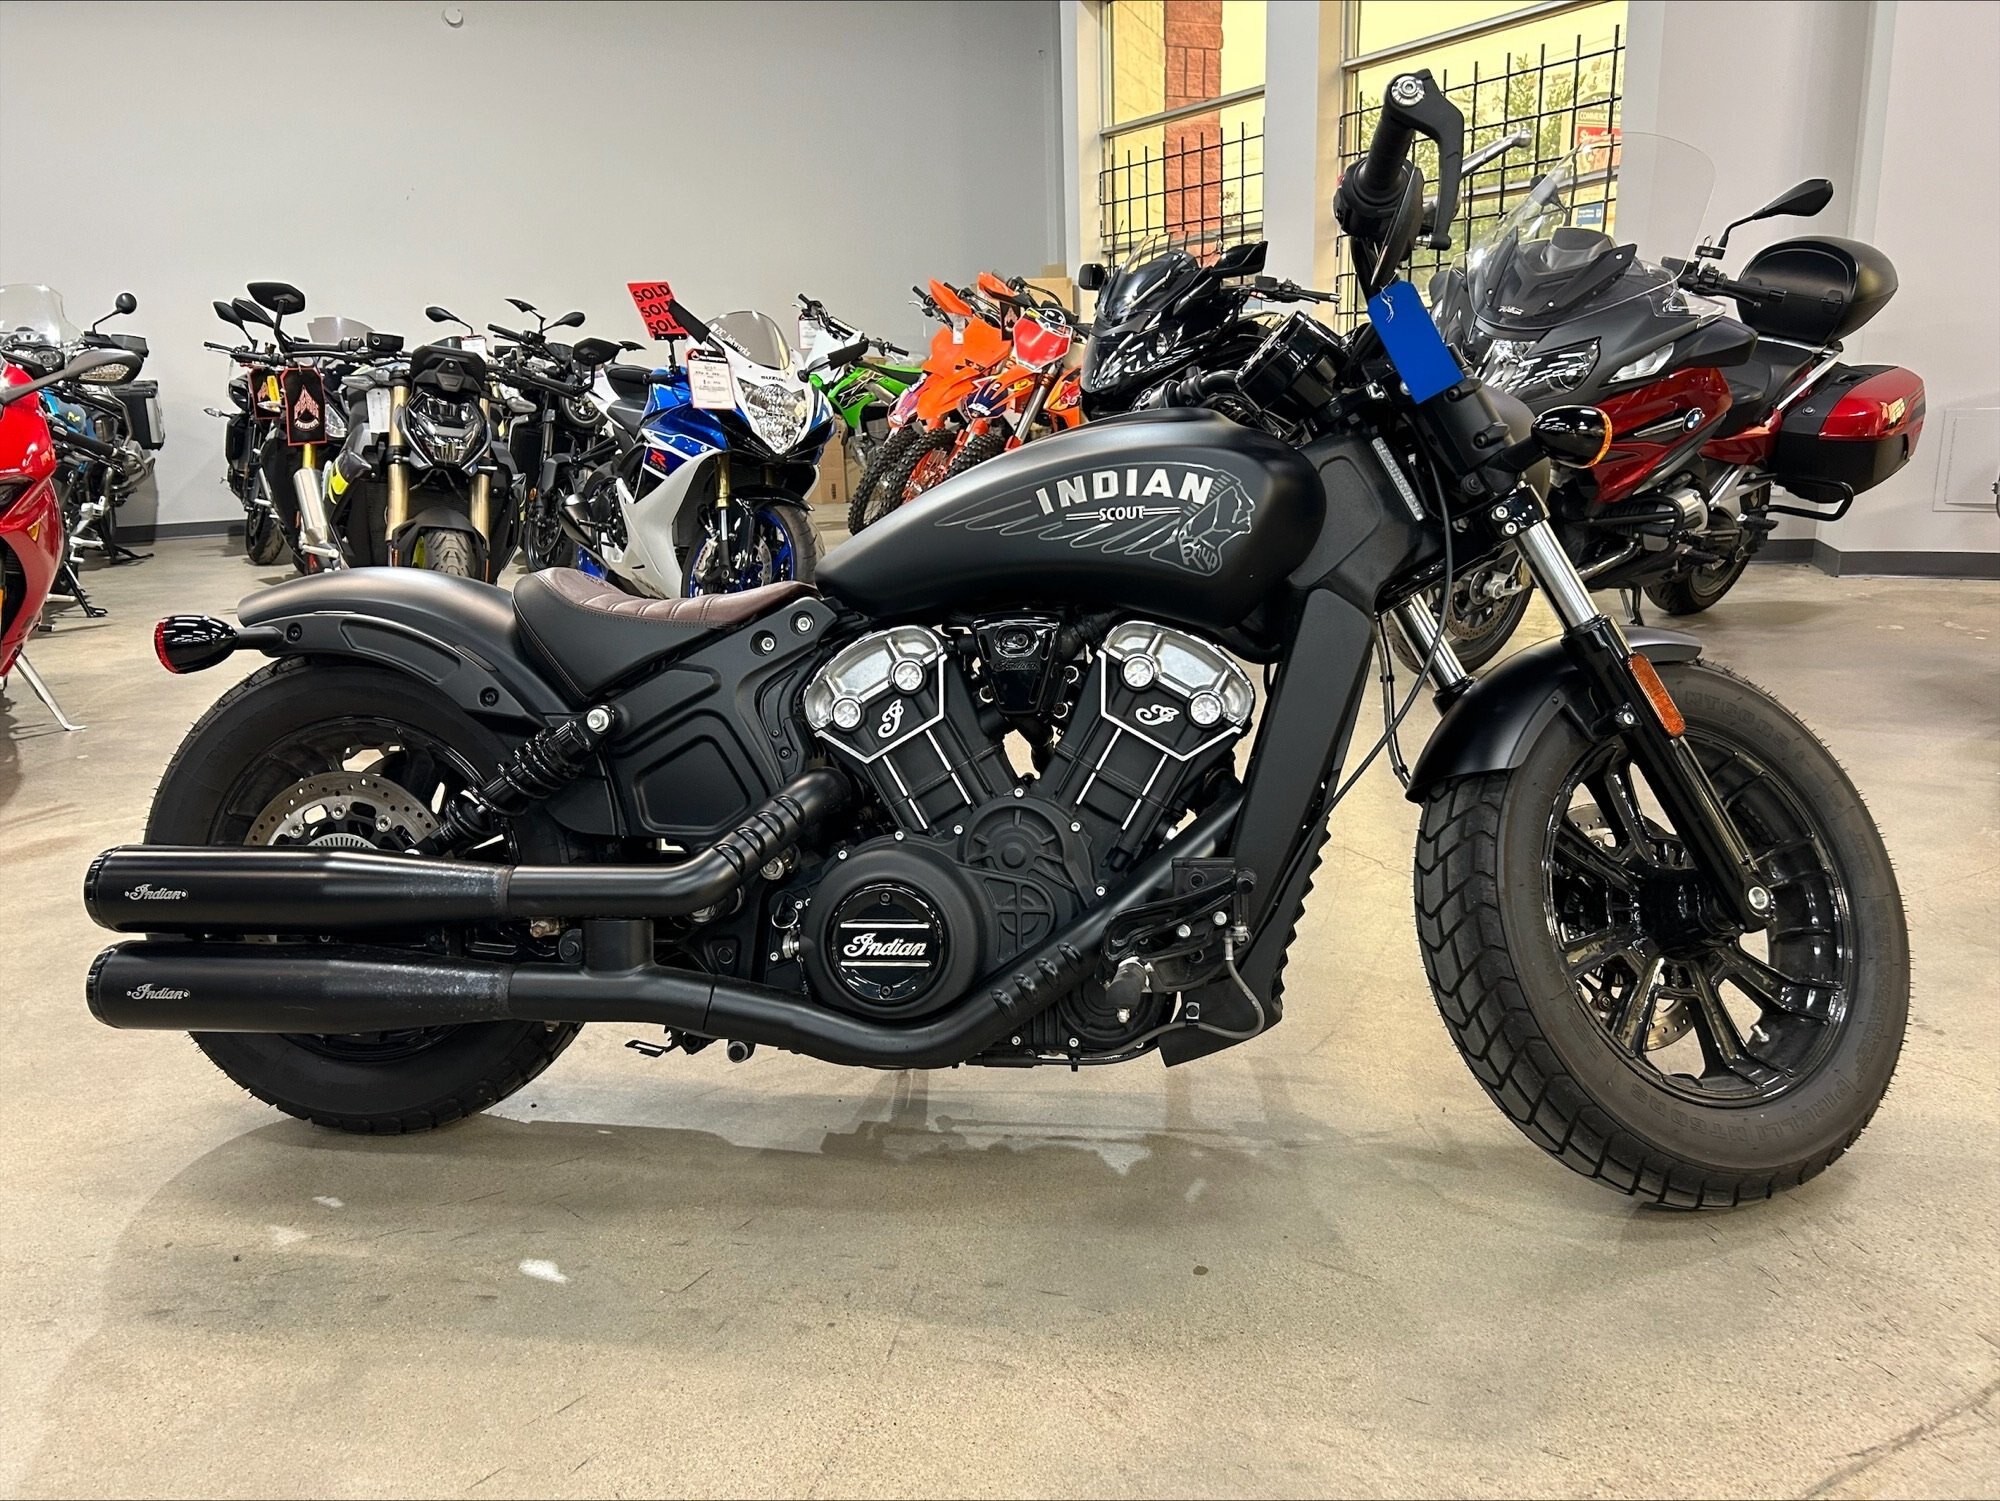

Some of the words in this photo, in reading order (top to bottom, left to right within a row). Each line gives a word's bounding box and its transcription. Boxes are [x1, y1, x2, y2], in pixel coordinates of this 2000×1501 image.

[632, 284, 671, 302] SOLD
[640, 302, 669, 318] SOL
[648, 320, 679, 334] SOL
[1036, 469, 1214, 515] INDIAN
[1099, 506, 1145, 521] SCOUT
[129, 883, 181, 900] Indian
[843, 933, 927, 957] Indian
[131, 983, 183, 1000] Indian
